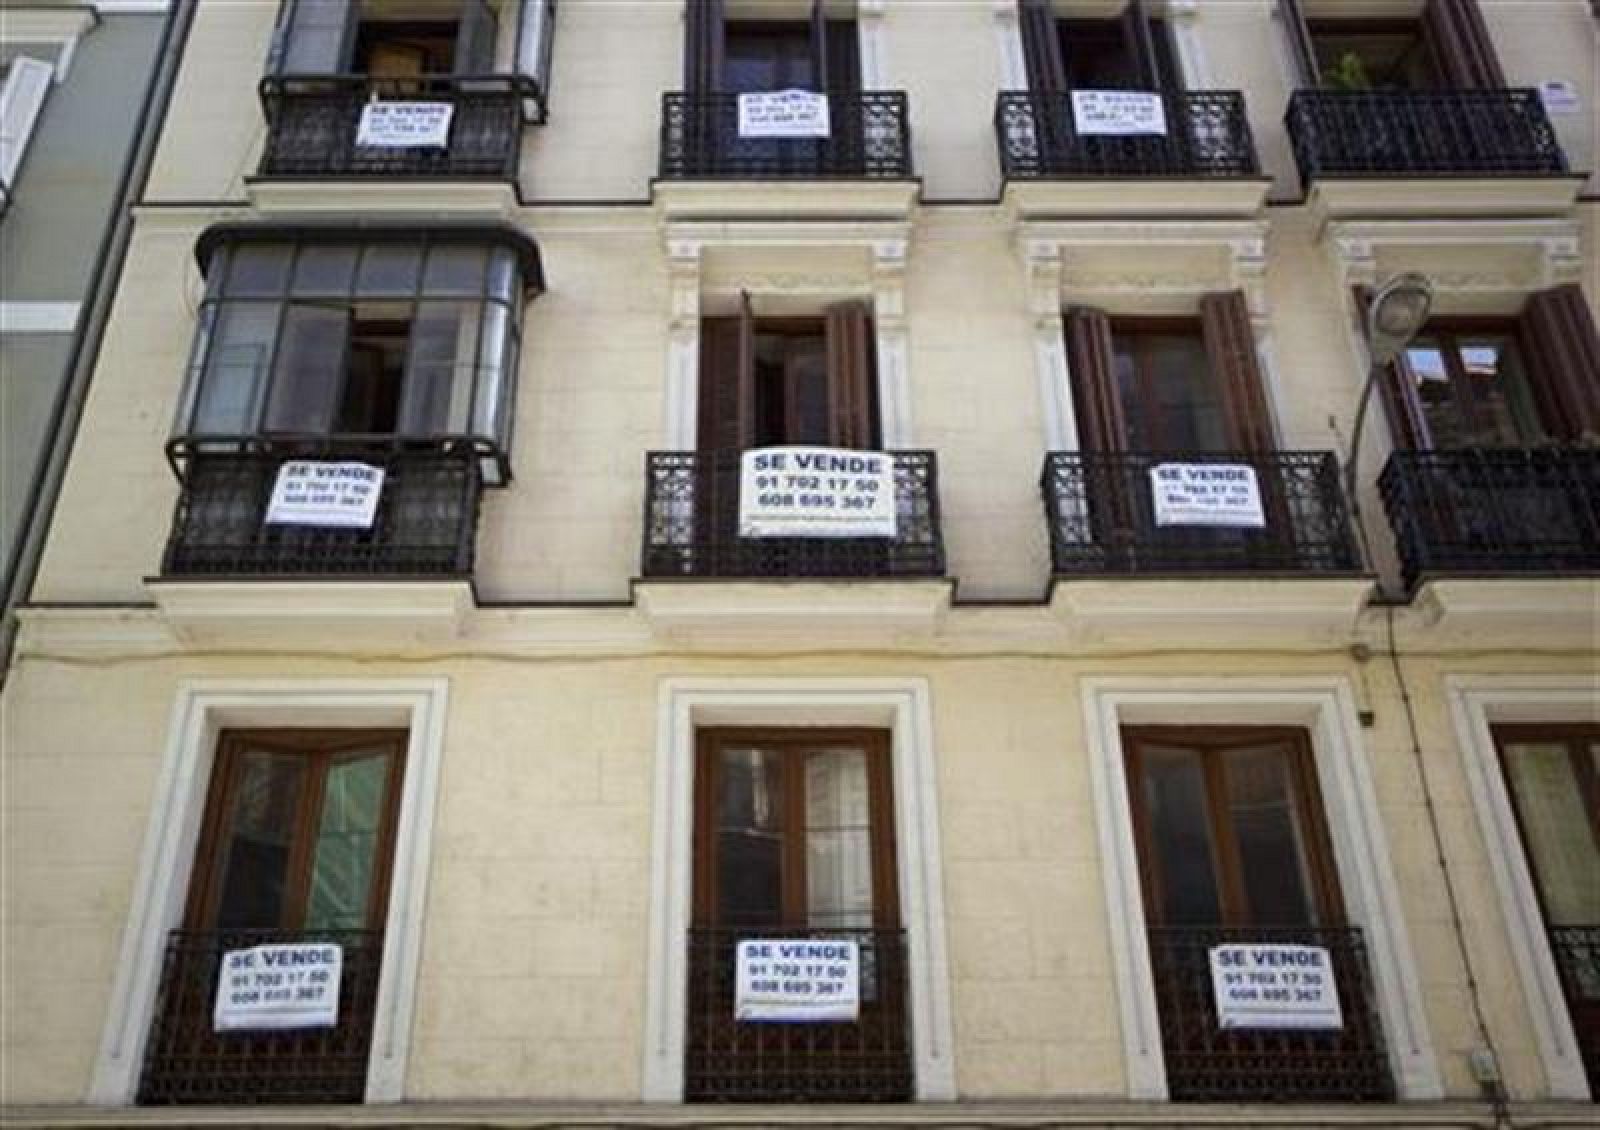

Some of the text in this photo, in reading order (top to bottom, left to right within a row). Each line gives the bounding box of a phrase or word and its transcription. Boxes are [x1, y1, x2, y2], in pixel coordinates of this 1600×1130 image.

[755, 453, 882, 475] SE VENDE
[286, 465, 376, 483] SE VENDE
[1157, 468, 1249, 482] SE VENDE
[755, 474, 880, 493] 91 702 17 50
[757, 493, 877, 511] 608 695 367
[229, 948, 335, 969] SE VENDE
[746, 944, 850, 961] SE VENDE
[1218, 949, 1324, 968] SE VENDE
[748, 963, 768, 977] 91
[772, 962, 801, 978] 702
[805, 964, 824, 978] 17
[1223, 971, 1244, 985] 91
[1247, 971, 1277, 986] 702
[1280, 971, 1300, 985] 17
[255, 971, 283, 988] 702
